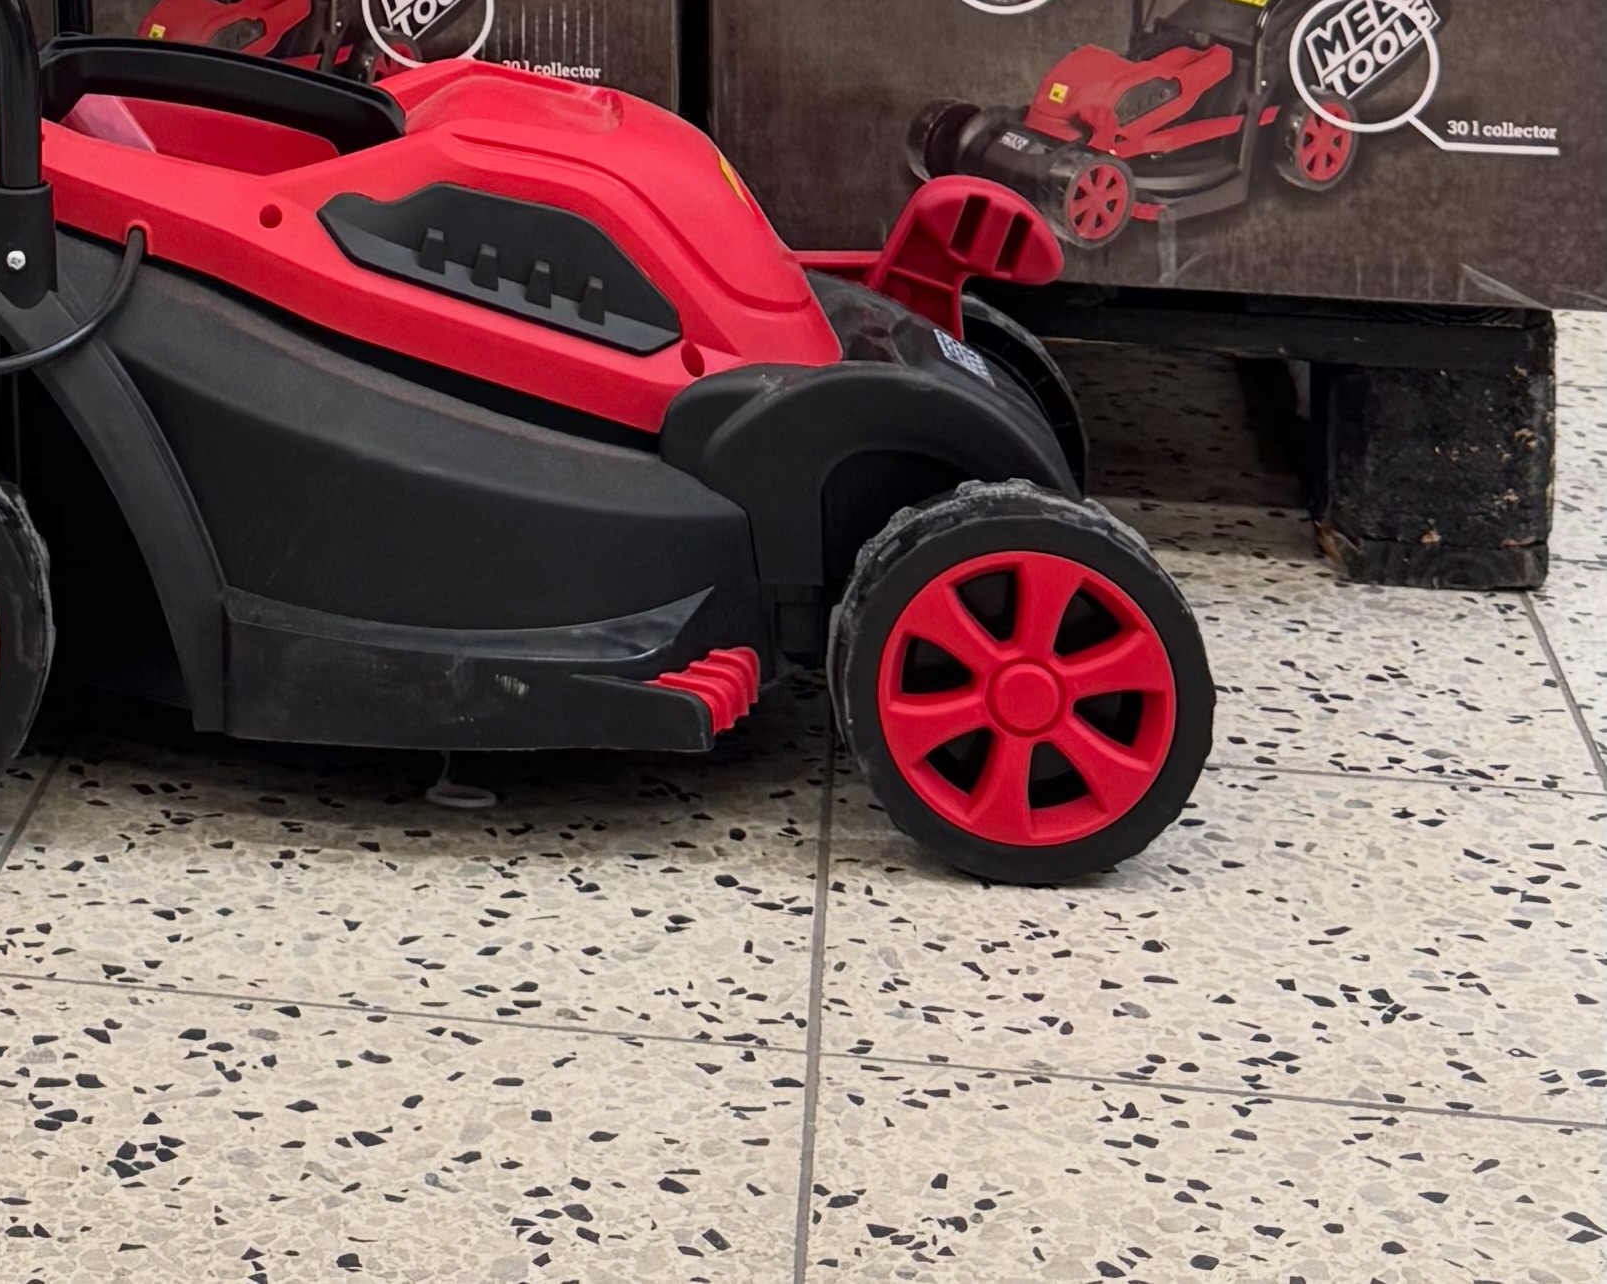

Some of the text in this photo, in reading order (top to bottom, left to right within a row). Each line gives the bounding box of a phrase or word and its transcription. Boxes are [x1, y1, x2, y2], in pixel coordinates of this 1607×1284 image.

[533, 61, 602, 79] collector
[1447, 119, 1470, 136] 30
[1482, 121, 1558, 140] collector
